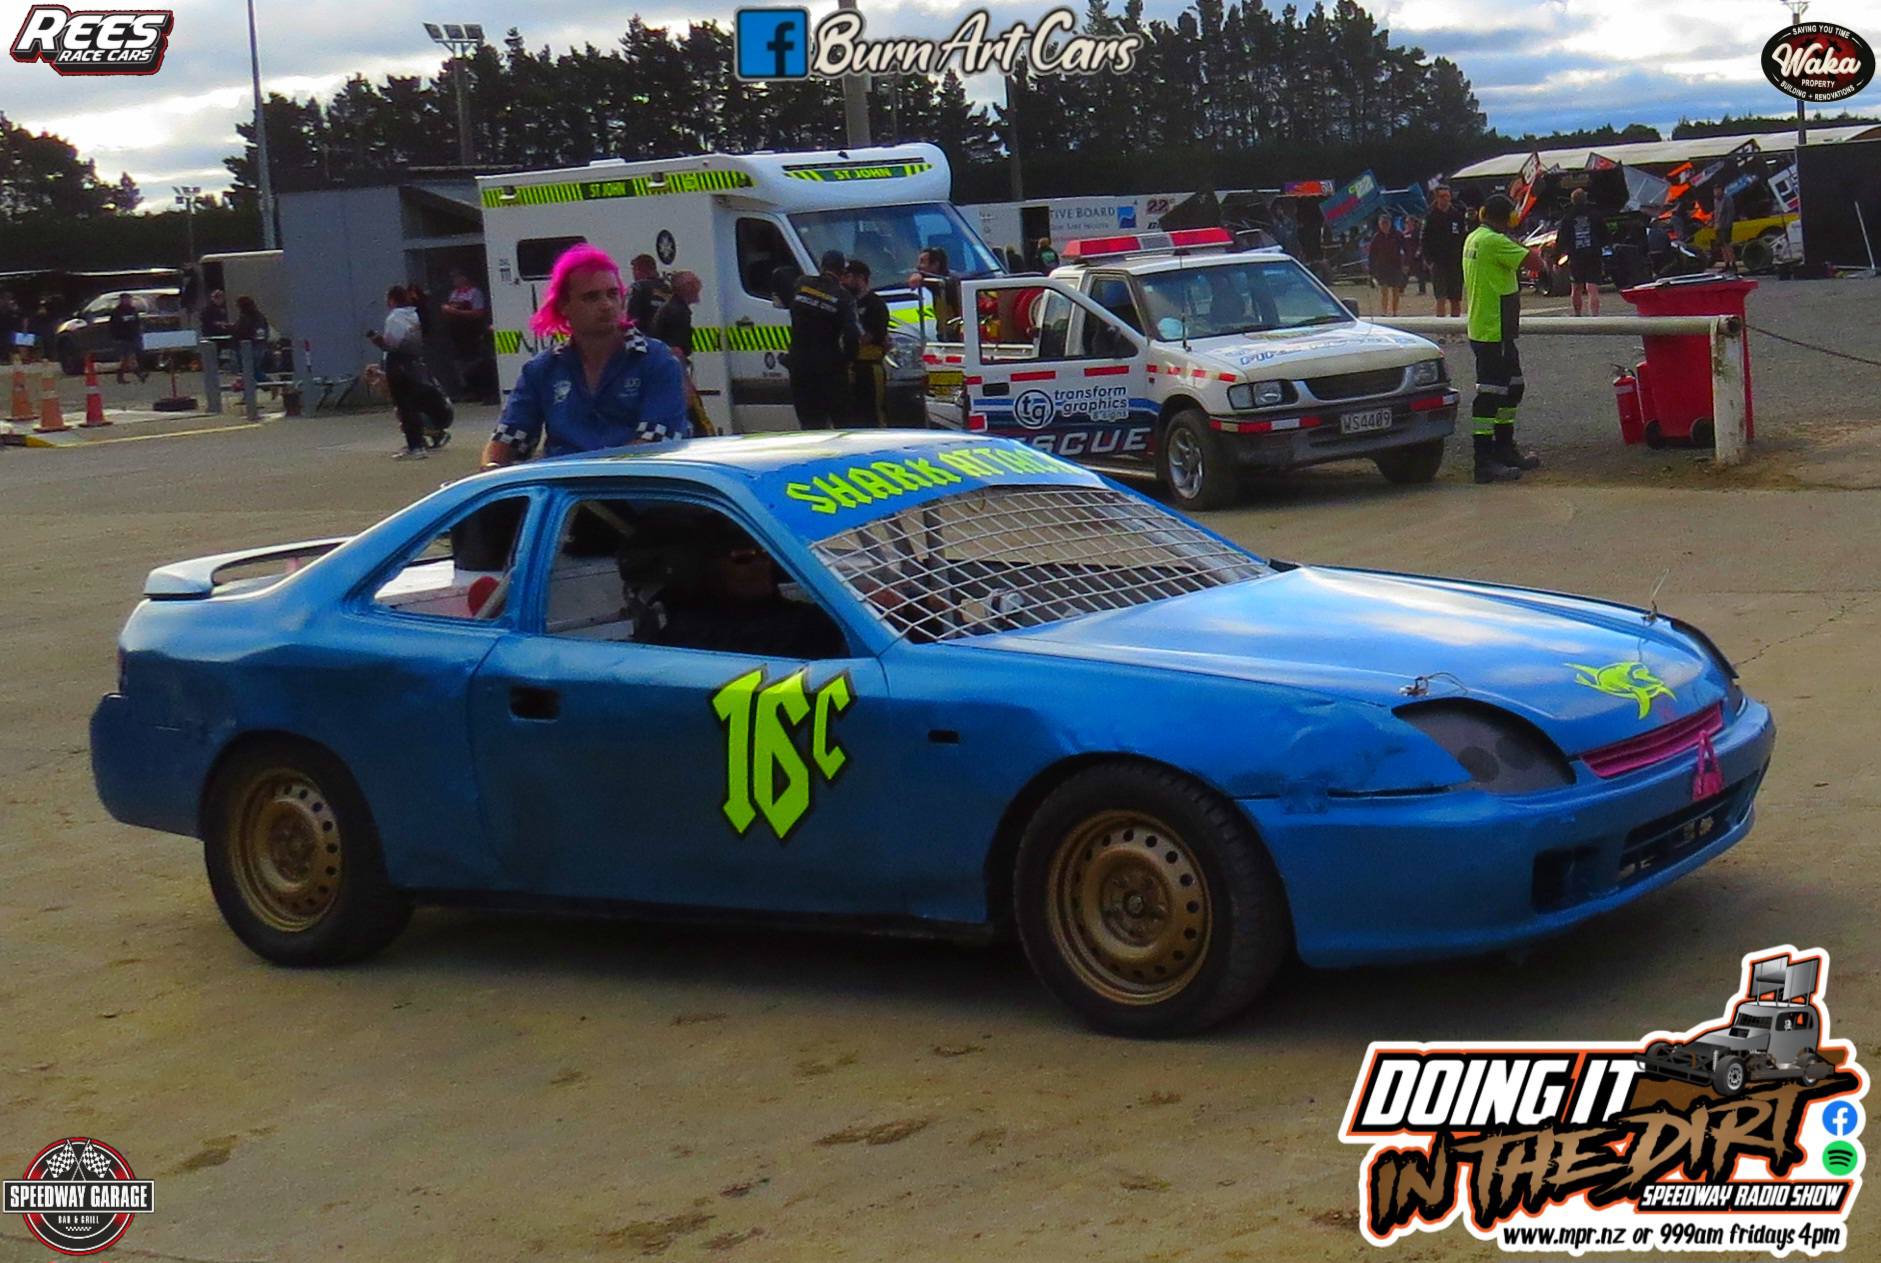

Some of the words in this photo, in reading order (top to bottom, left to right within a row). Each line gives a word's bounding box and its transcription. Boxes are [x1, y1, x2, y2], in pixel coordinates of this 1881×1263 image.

[834, 170, 851, 180] ST
[854, 168, 892, 179] JOHN
[589, 184, 601, 198] ST
[602, 182, 626, 197] JOHN
[1076, 206, 1116, 218] BOARD
[1054, 385, 1127, 401] transform
[1063, 397, 1128, 415] graphics
[1343, 411, 1391, 432] WS4409
[786, 457, 962, 514] SHARK
